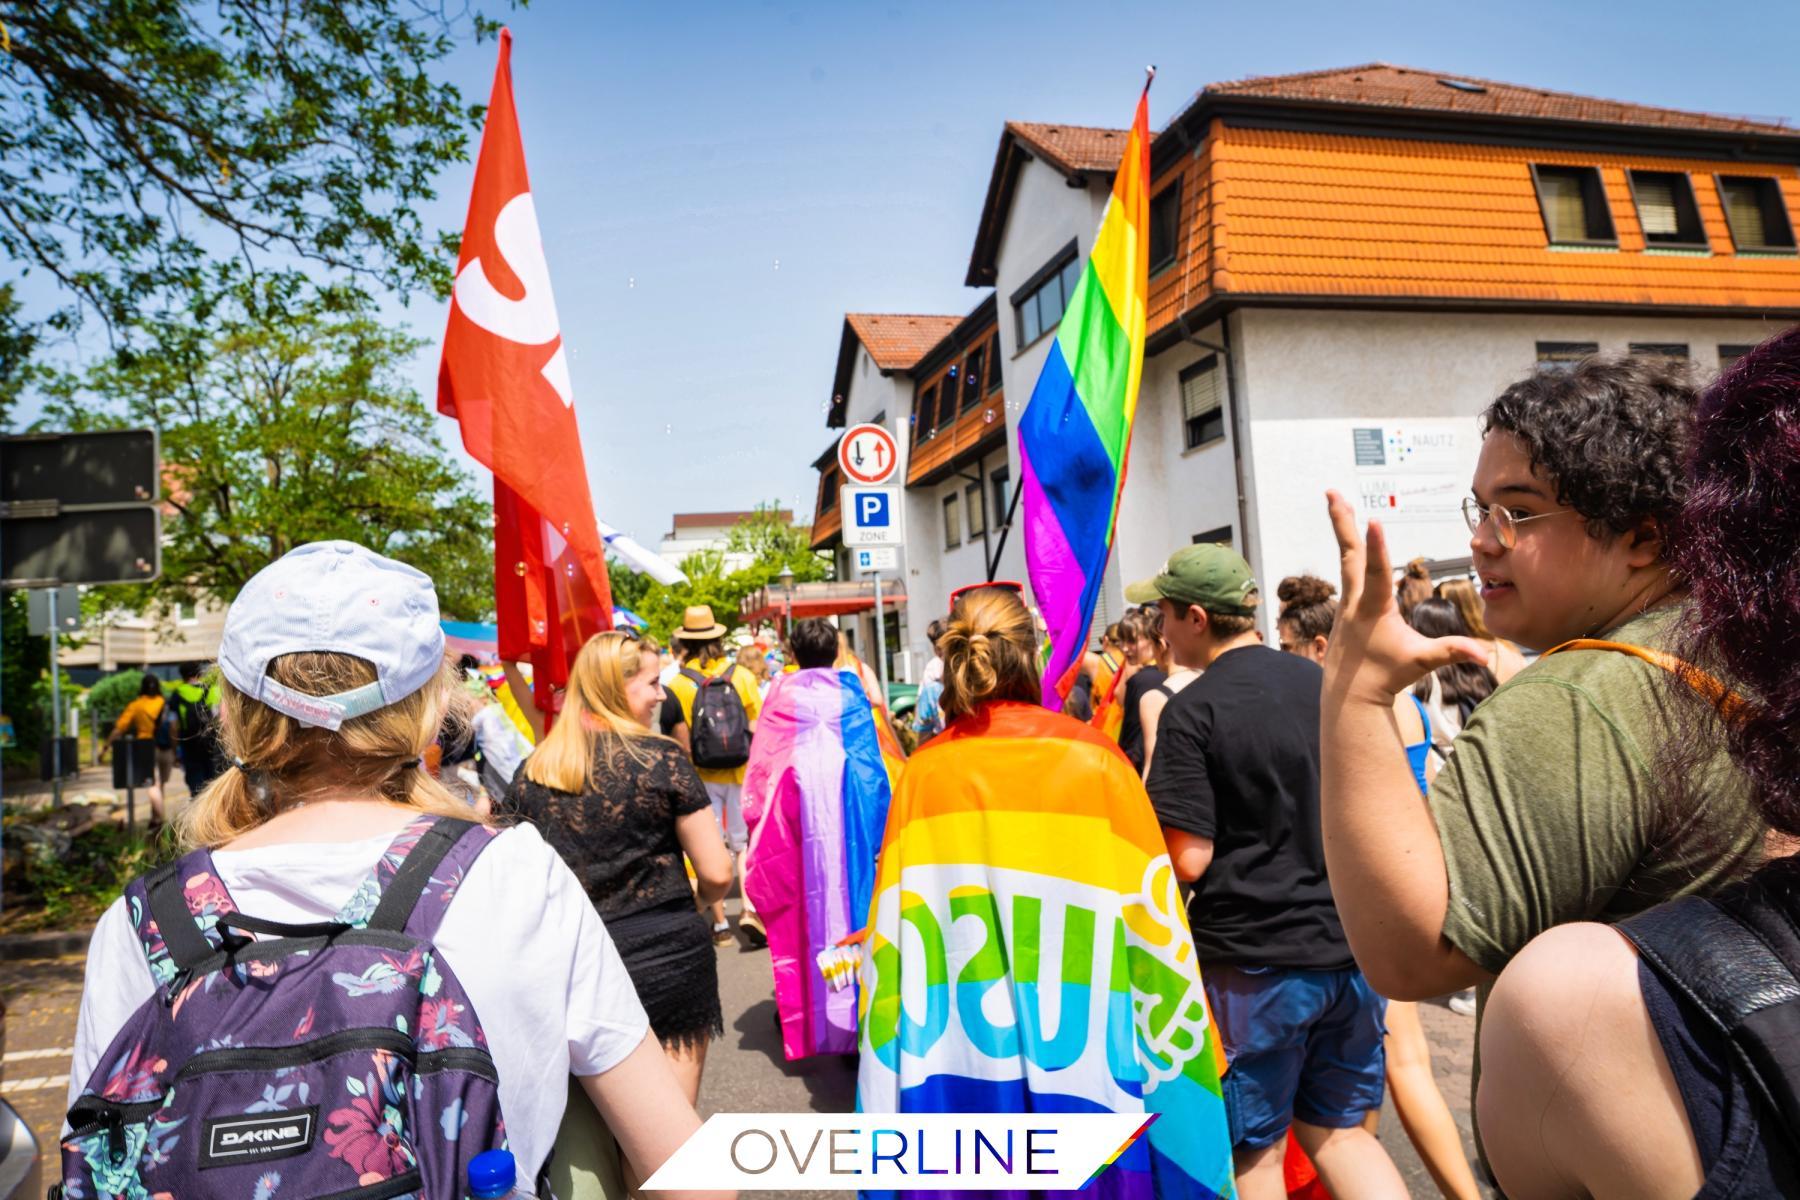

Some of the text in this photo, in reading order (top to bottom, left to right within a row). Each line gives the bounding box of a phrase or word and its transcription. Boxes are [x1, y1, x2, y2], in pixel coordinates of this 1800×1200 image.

[1412, 433, 1455, 447] NAUTZ
[1362, 494, 1388, 508] TEC
[862, 497, 882, 523] P
[859, 531, 888, 542] ZONE
[220, 1126, 301, 1146] DAKINE
